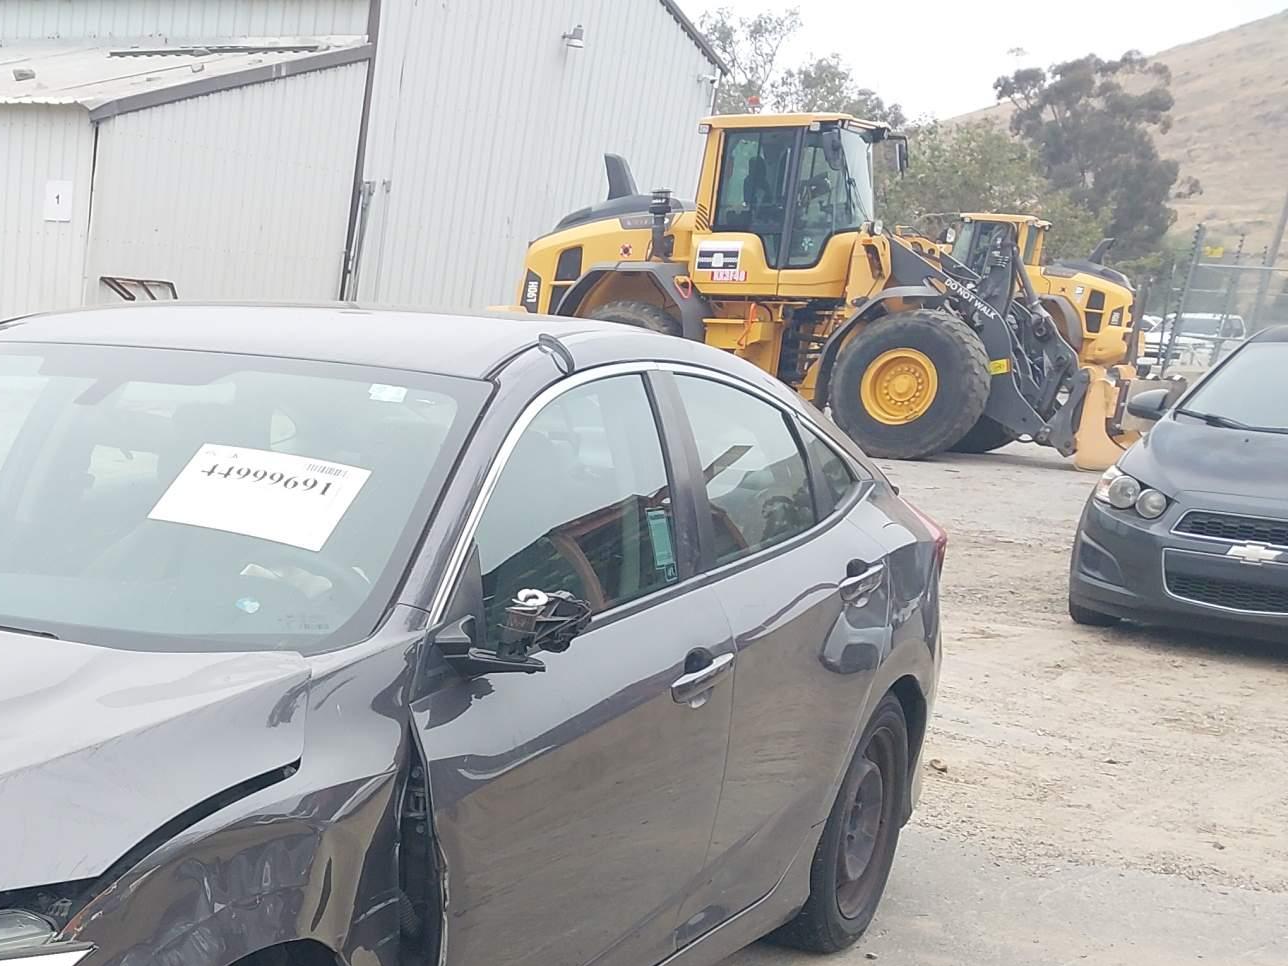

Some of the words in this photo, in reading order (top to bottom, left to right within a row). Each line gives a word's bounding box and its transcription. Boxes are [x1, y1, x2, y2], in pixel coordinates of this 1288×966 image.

[55, 194, 61, 205] 1
[526, 281, 539, 303] L90H
[944, 279, 958, 291] DO
[956, 287, 976, 303] NOT
[974, 299, 997, 320] WALK
[201, 463, 333, 496] 44999691
